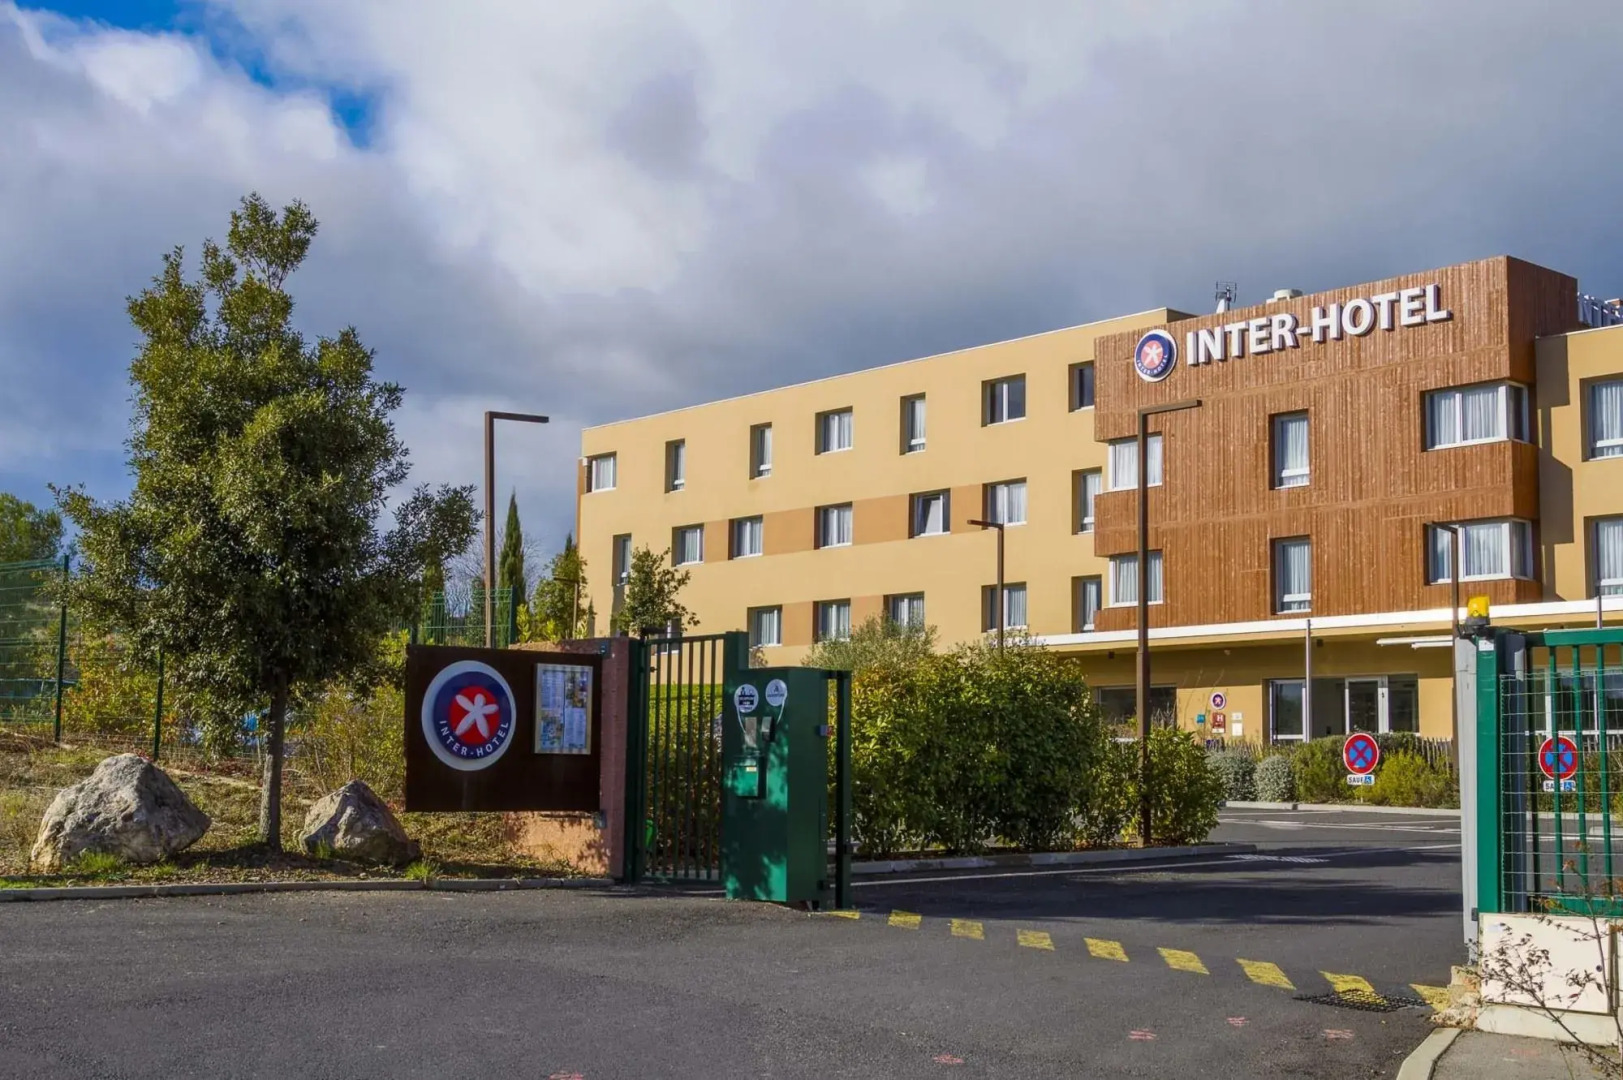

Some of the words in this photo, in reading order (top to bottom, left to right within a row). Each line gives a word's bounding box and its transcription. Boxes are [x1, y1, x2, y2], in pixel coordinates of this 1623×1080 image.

[1186, 283, 1452, 366] INTER-HOTEL
[1136, 354, 1168, 374] INTER-HOTEL
[439, 720, 510, 756] INTER-HOTEL
